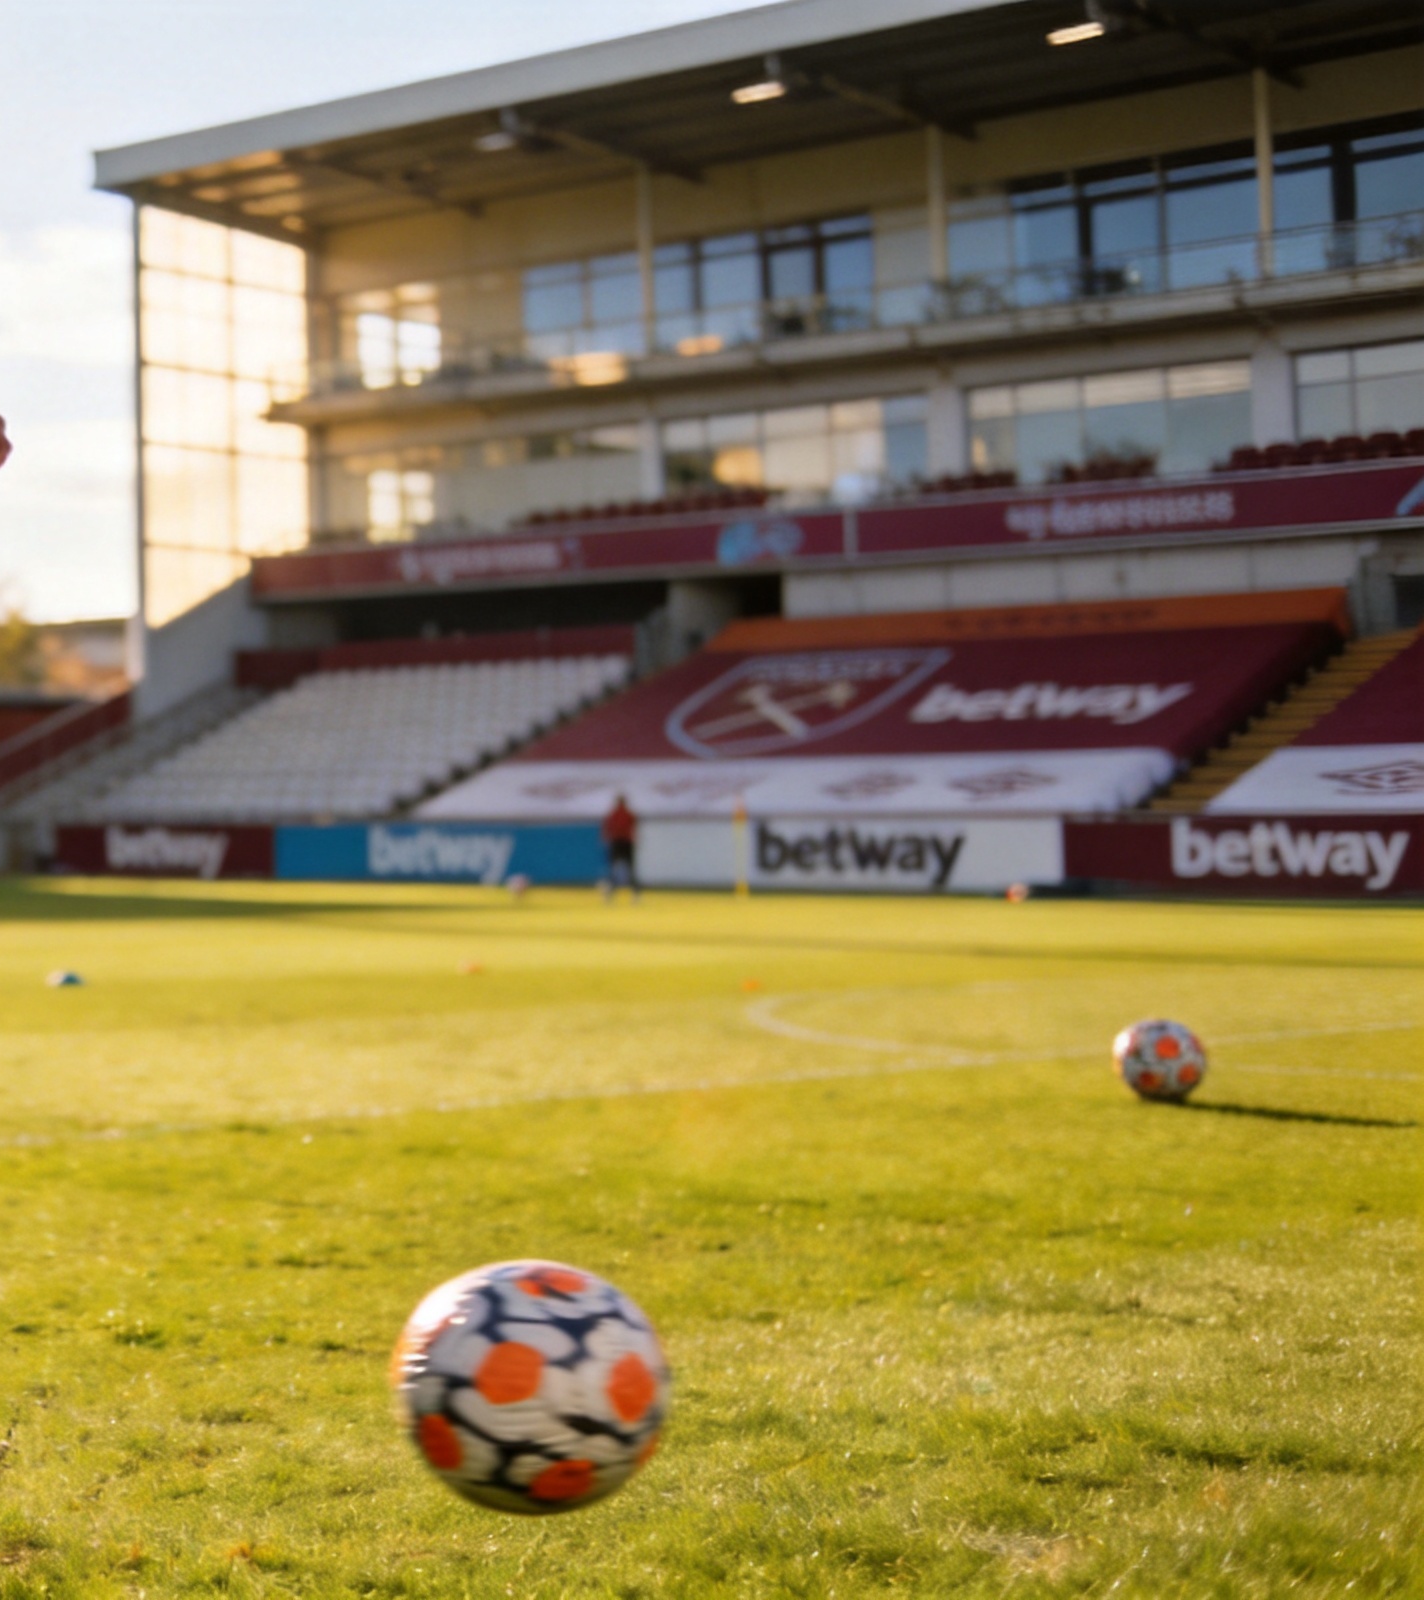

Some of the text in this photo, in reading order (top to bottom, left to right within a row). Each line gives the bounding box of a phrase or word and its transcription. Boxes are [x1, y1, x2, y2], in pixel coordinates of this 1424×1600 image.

[910, 683, 1192, 724] betway
[106, 827, 228, 879] betway
[367, 827, 514, 884] betway
[756, 826, 965, 885] betway
[1172, 821, 1410, 888] betway
